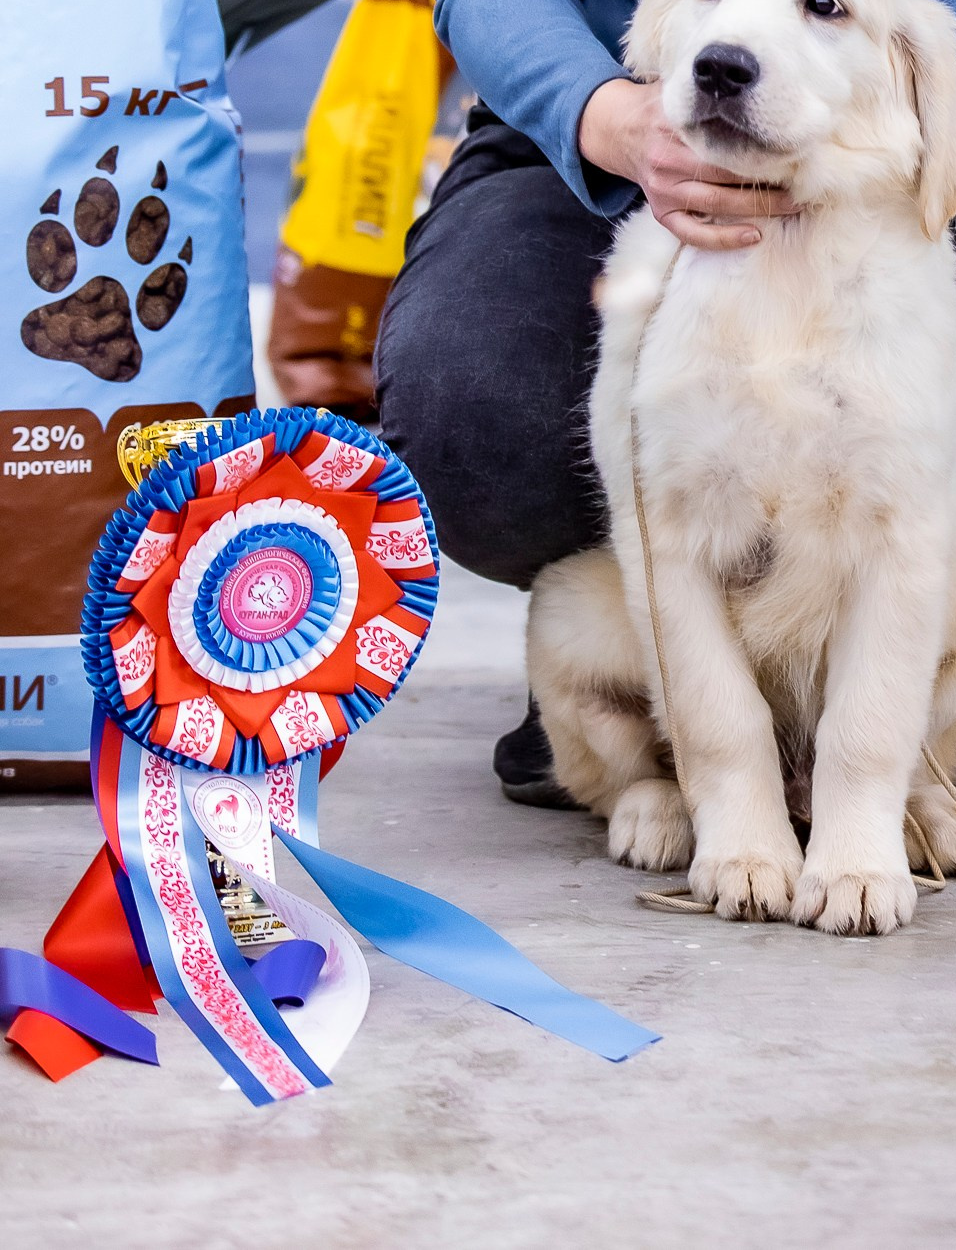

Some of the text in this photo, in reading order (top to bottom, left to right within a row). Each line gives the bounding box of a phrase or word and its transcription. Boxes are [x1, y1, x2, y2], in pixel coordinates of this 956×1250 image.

[44, 75, 208, 118] 15 кг
[12, 424, 86, 453] 28%
[3, 459, 92, 480] протеин
